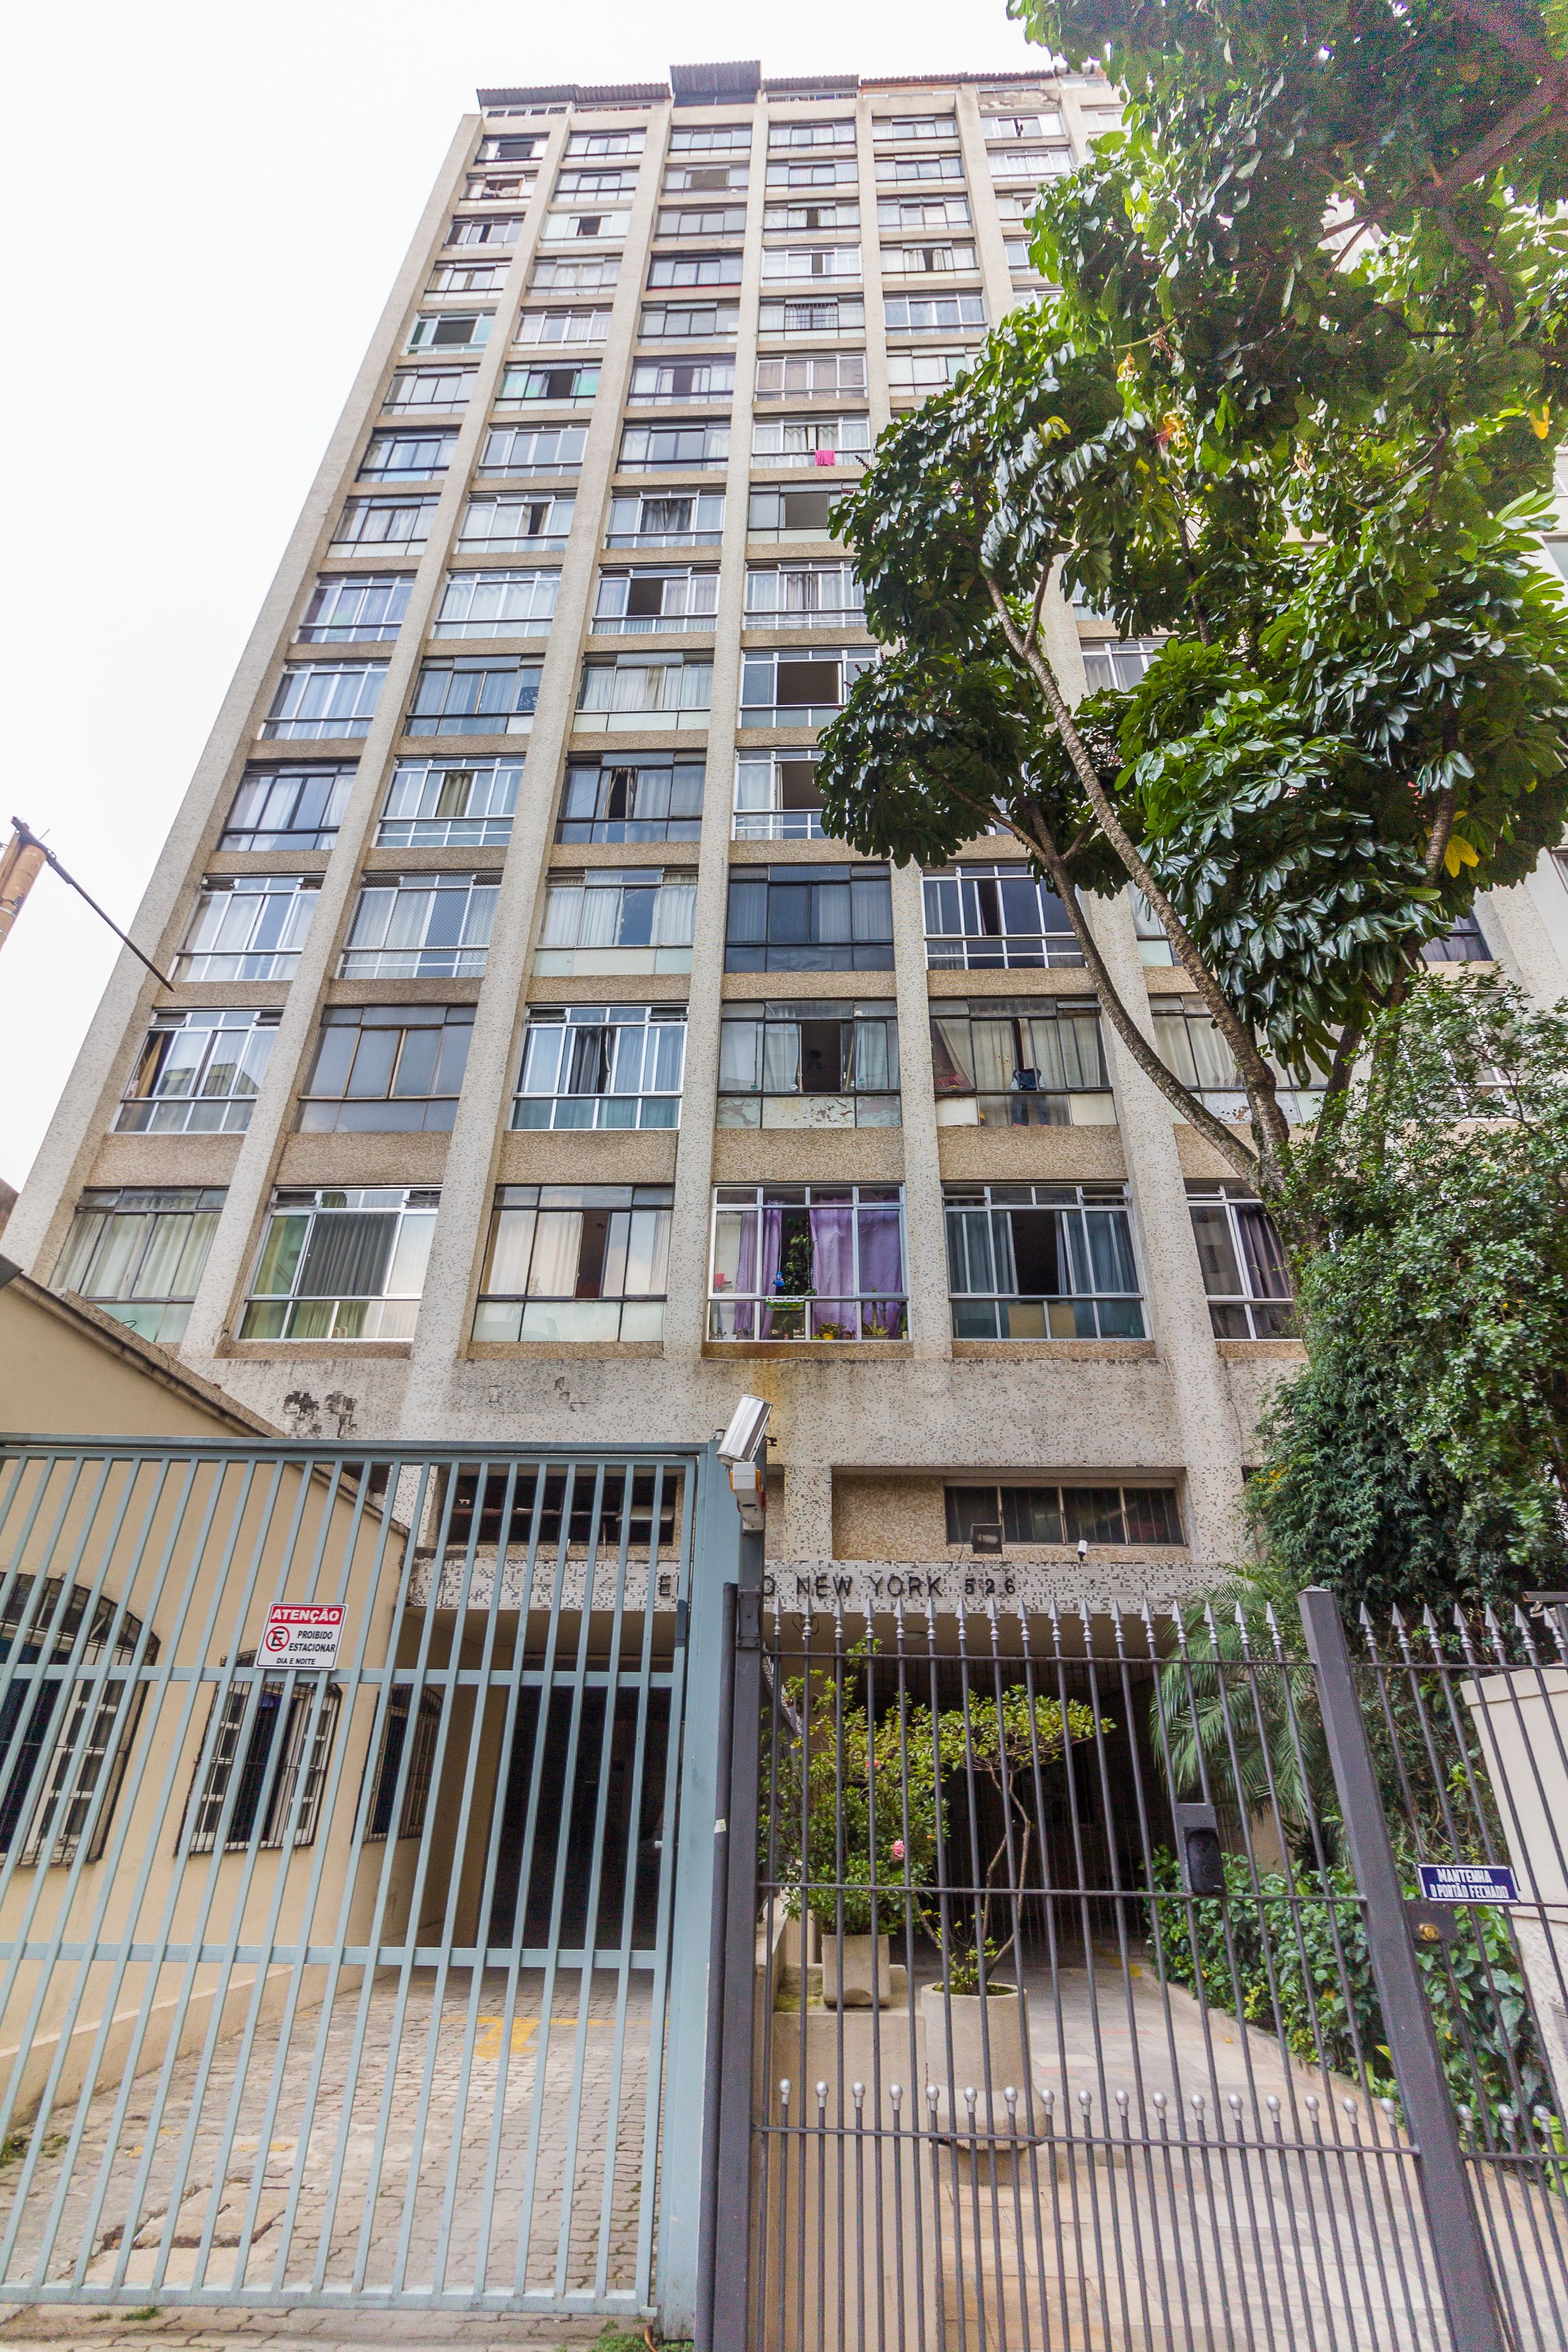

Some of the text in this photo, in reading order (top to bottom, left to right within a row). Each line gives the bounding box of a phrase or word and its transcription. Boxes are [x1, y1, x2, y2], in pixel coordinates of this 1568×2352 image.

[796, 1575, 851, 1597] NEW
[868, 1575, 943, 1597] YORK
[964, 1576, 1016, 1595] 526
[272, 1608, 340, 1623] ATENÇÃO
[297, 1631, 333, 1639] PROIBIDO
[289, 1643, 336, 1652] ESTACIONAR
[1437, 1868, 1492, 1883] MANTENHA
[1430, 1882, 1509, 1899] O PORTÃO FECHADO
